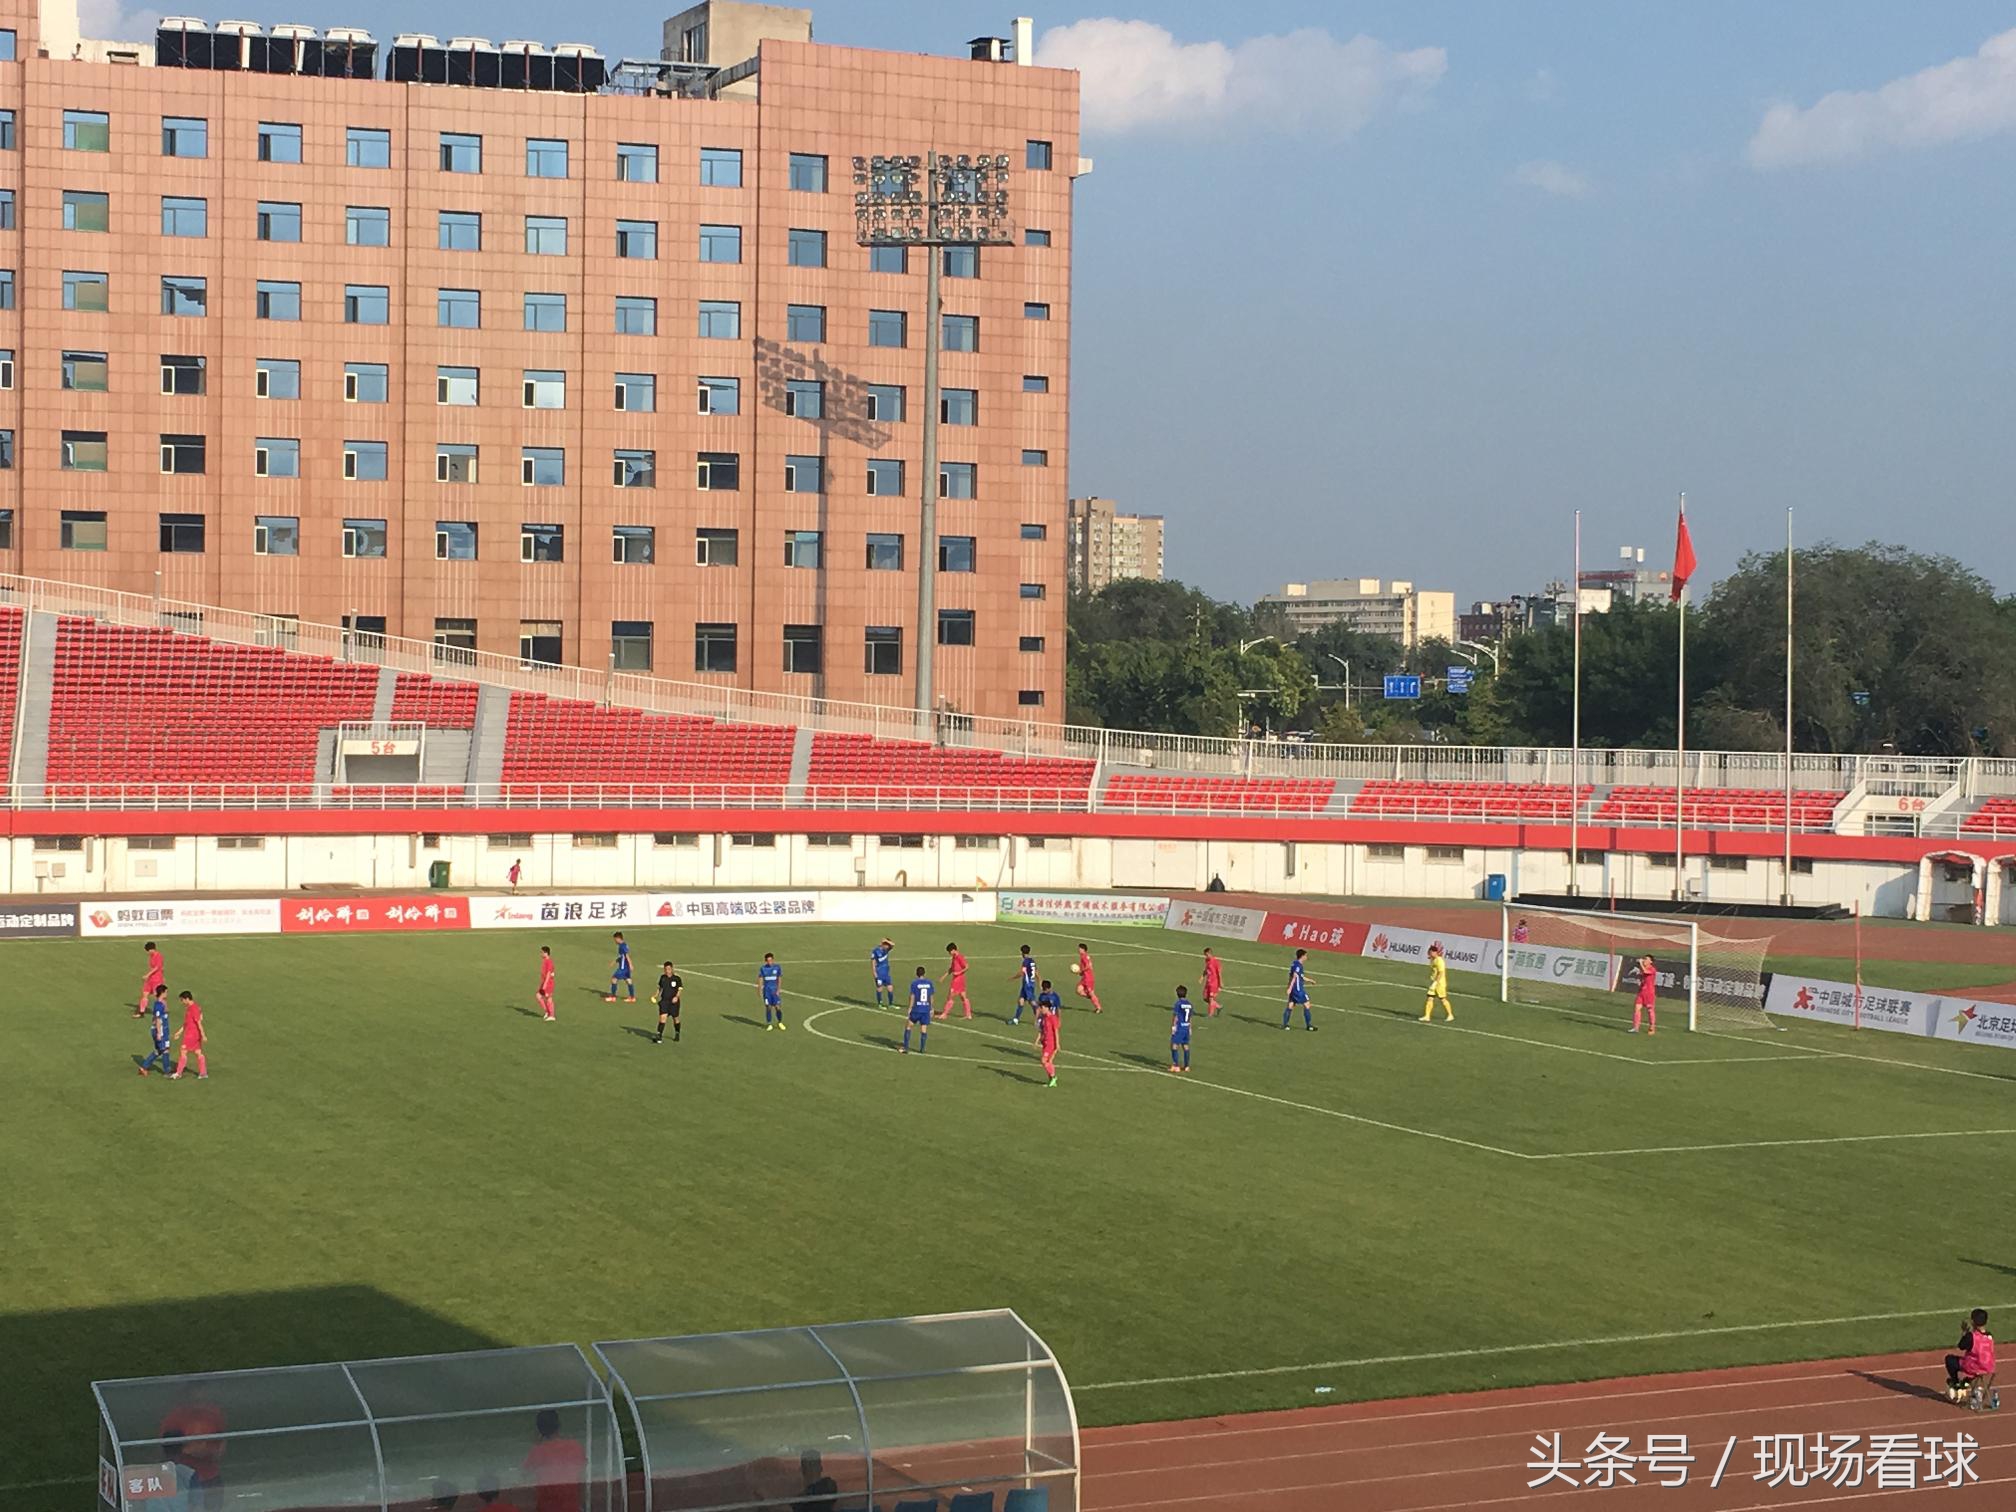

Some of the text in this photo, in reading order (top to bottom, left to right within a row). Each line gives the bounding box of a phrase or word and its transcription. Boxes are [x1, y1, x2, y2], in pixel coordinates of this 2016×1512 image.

[541, 901, 628, 920] 茵浪足球
[687, 900, 815, 916] 中国高端吸尘器品牌
[1388, 942, 1421, 955] HUAWEI
[1444, 951, 1478, 963] HUAWEI
[1818, 991, 1912, 1017] 中国城市足球联赛
